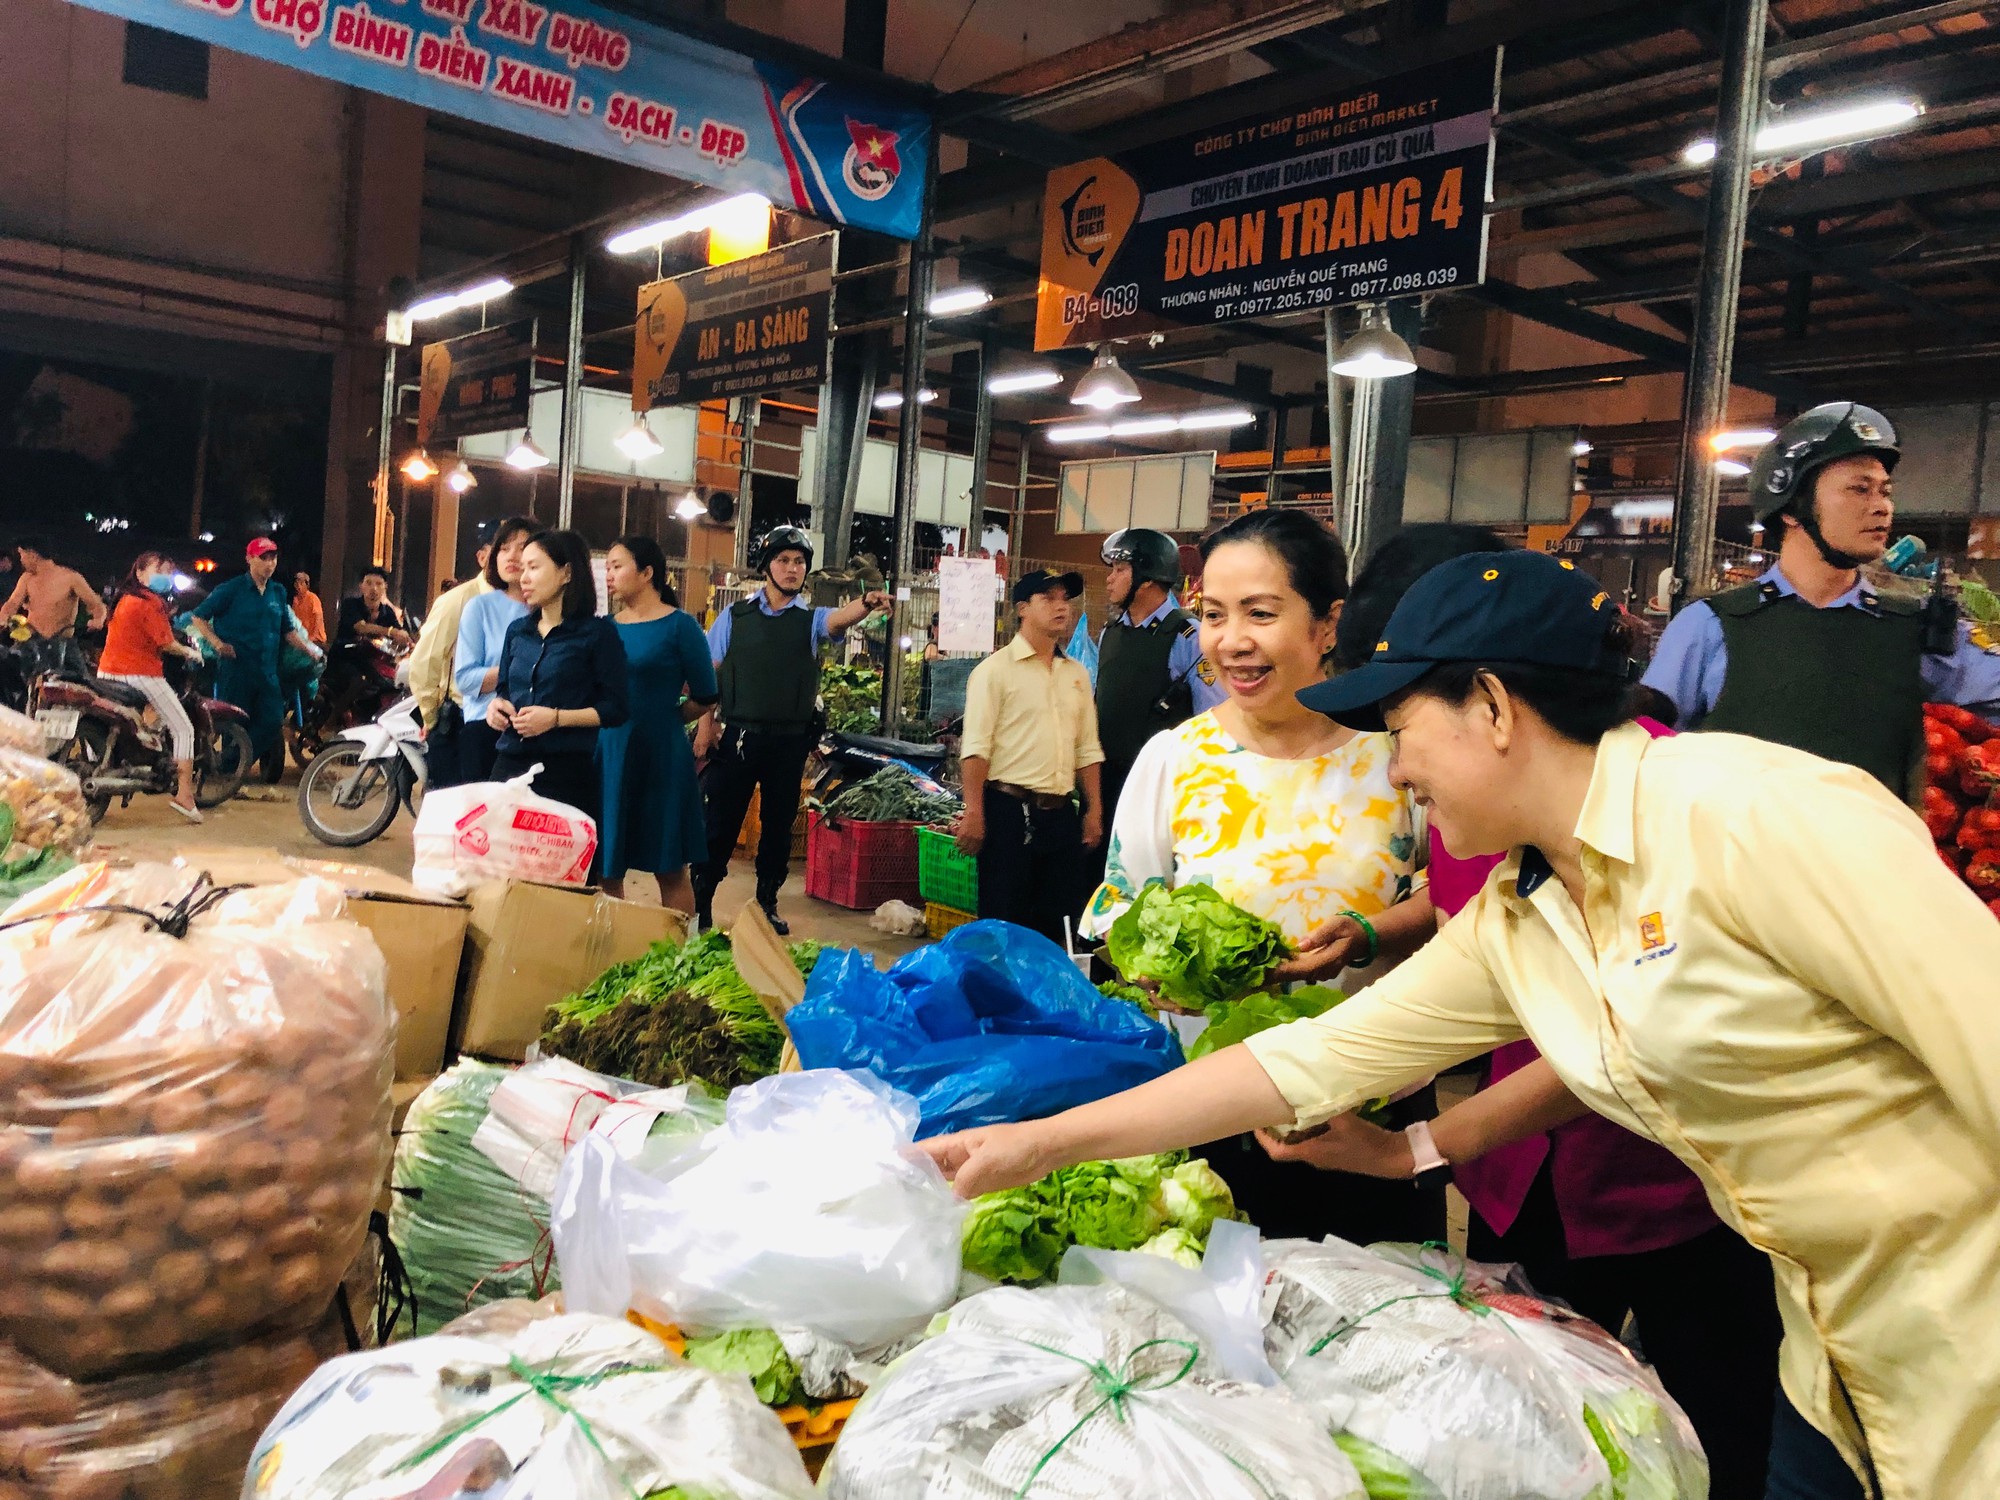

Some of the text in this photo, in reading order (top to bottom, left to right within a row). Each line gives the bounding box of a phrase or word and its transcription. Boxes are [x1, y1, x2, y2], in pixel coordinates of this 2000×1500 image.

[550, 16, 628, 69] DỰNG
[254, 0, 324, 43] CHỢ
[334, 5, 410, 62] BÌNH
[418, 29, 488, 86] ĐIỀN
[493, 61, 573, 111] XANH
[606, 97, 675, 141] SẠCH
[700, 122, 746, 166] ĐẸP
[1237, 126, 1256, 145] TY
[1337, 145, 1371, 174] RAU
[1164, 166, 1465, 282] ĐOAN TRANG 4
[1160, 290, 1207, 310] THƯƠNG
[1252, 268, 1307, 294] NGUYỄN
[1308, 261, 1339, 285] QUẾ
[1340, 257, 1389, 279] TRANG
[1350, 266, 1459, 298] 0977.098.039
[735, 319, 756, 354] BA
[536, 834, 574, 849] ICHIBAN
